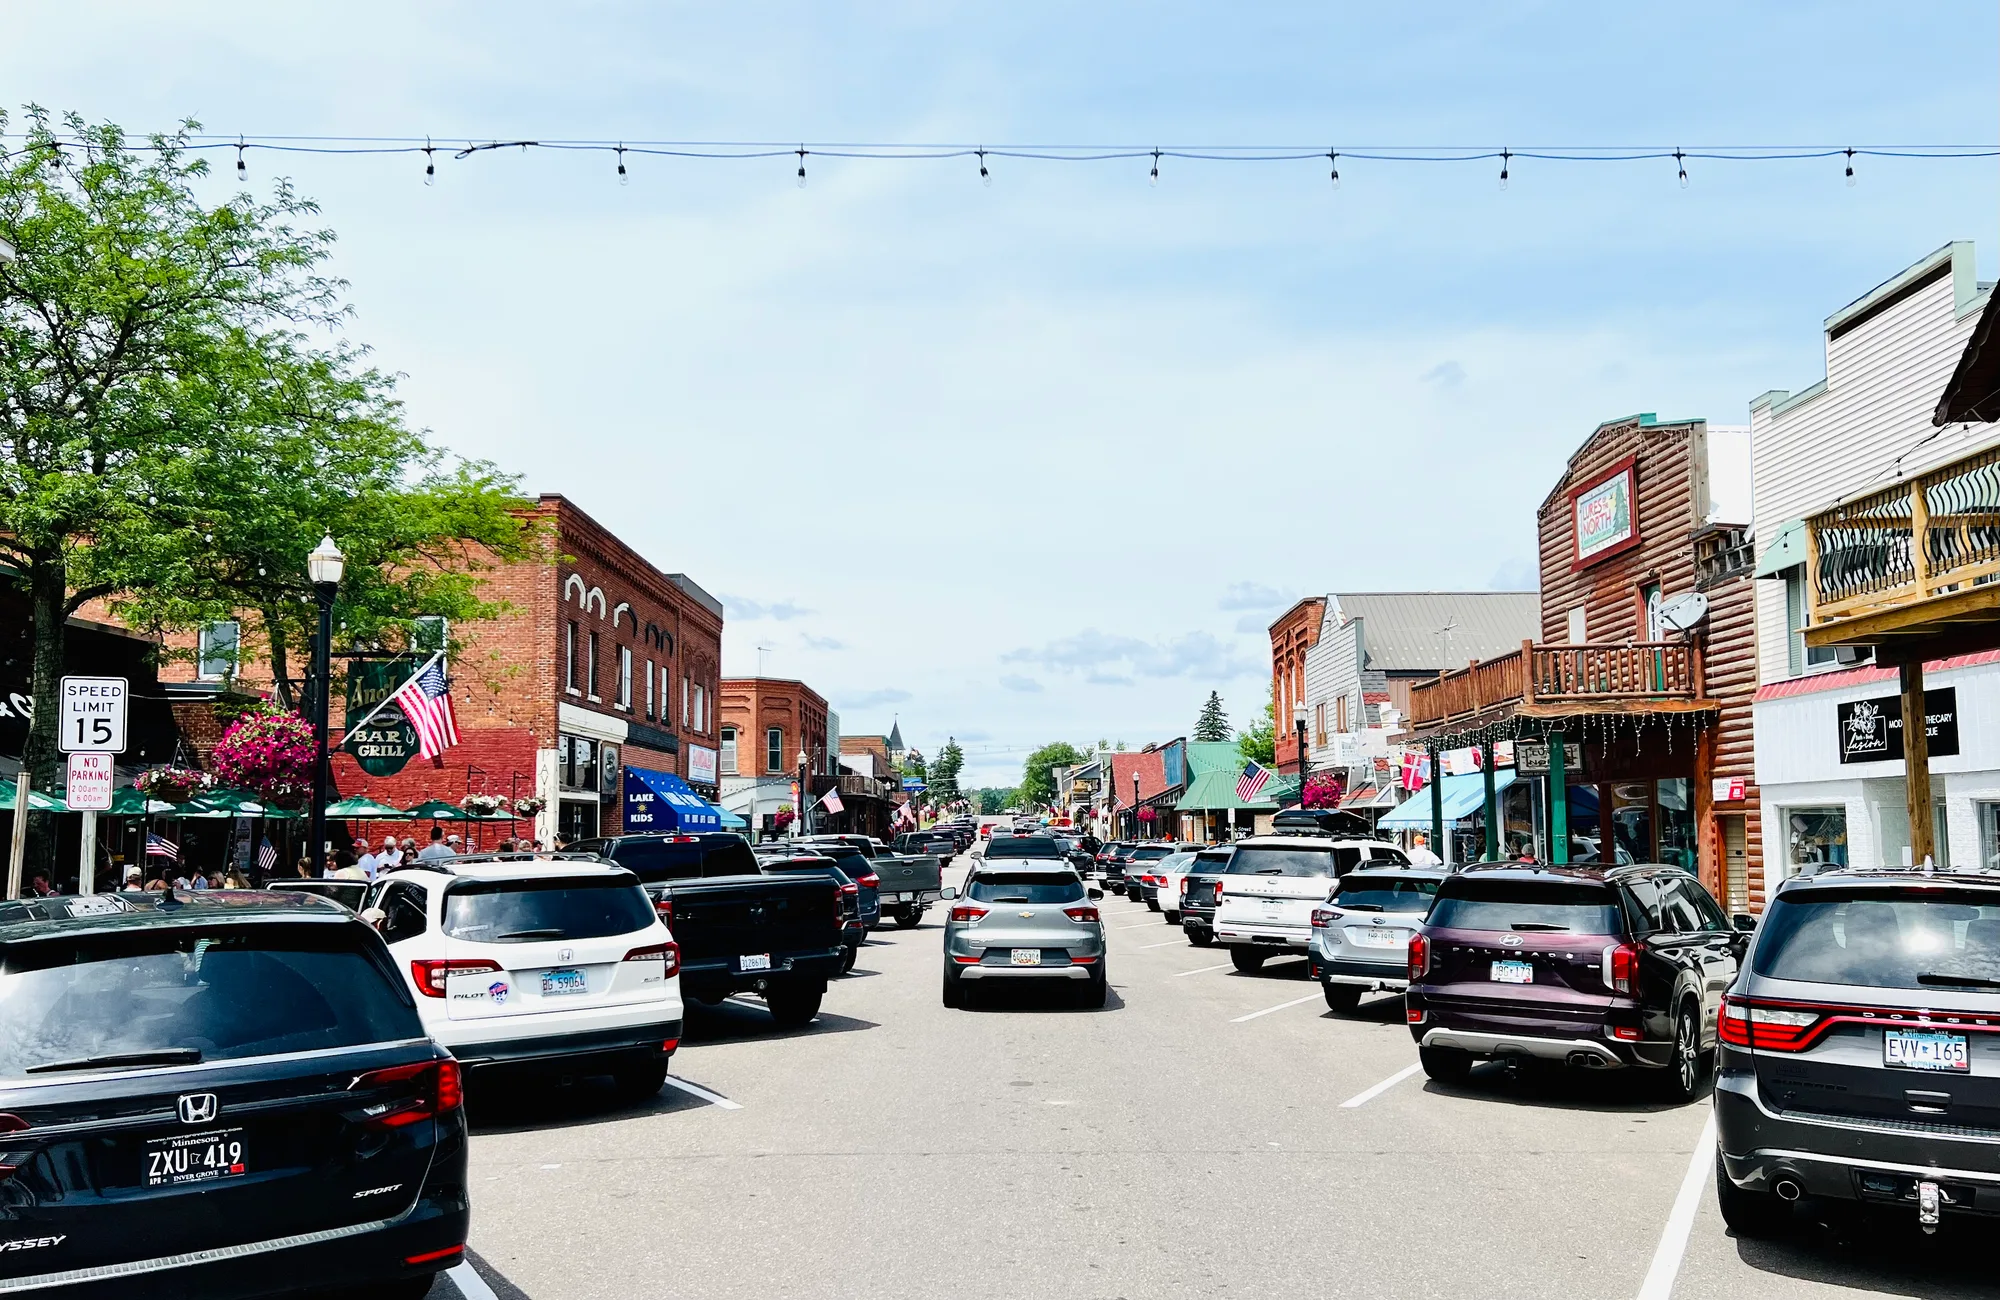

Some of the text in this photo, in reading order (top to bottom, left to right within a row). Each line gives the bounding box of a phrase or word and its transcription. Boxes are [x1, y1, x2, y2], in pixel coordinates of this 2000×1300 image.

[1583, 498, 1602, 520] LURES
[1582, 508, 1612, 539] NORTH
[67, 685, 121, 697] SPEED
[73, 701, 114, 713] LIMIT
[76, 717, 112, 745] 15
[353, 726, 416, 747] BAR &
[357, 744, 406, 757] GRILL
[1844, 732, 1885, 762] fusion
[83, 757, 98, 768] NO
[71, 770, 110, 781] PARKING
[629, 793, 654, 802] LAKE
[630, 814, 654, 823] KIDS
[1514, 967, 1531, 978] 173
[542, 976, 585, 991] BG 59064
[453, 992, 486, 1000] PILOT
[1862, 1011, 1988, 1026] DODGE
[1889, 1039, 1963, 1061] EVV 165
[171, 1136, 220, 1148] Minnesota
[148, 1141, 242, 1177] ZXU 419
[149, 1176, 162, 1186] APR
[173, 1169, 219, 1182] INVER GROVE
[352, 1183, 403, 1199] SPORT
